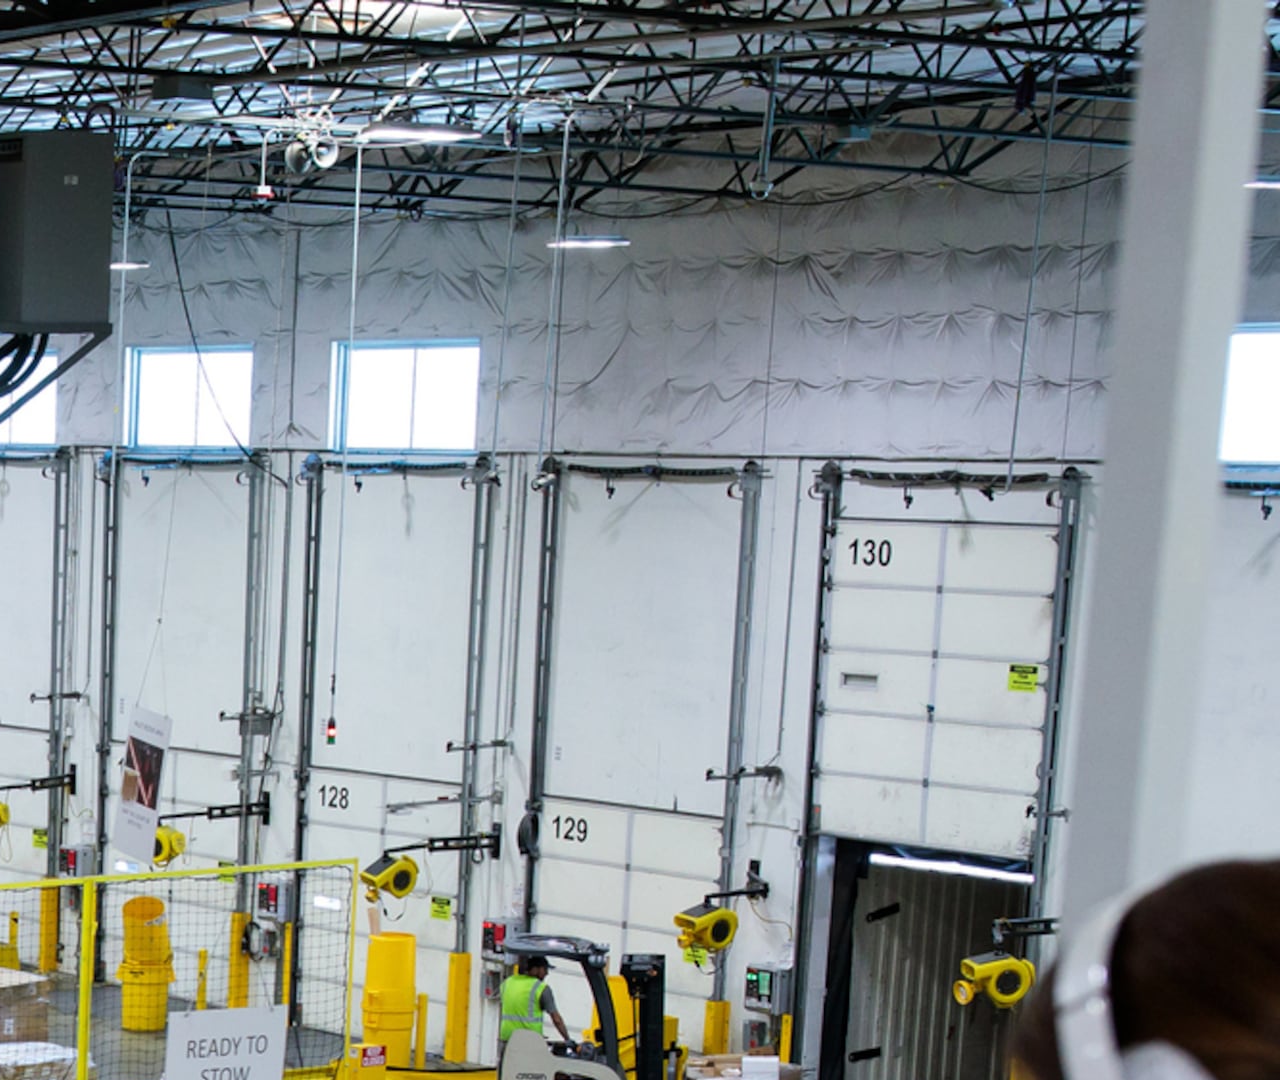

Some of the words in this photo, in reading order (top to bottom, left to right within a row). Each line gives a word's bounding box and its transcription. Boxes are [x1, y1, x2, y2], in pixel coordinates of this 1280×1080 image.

[848, 538, 893, 567] 130
[318, 784, 349, 809] 128
[552, 815, 588, 843] 129
[186, 1036, 242, 1059] READY
[246, 1034, 269, 1054] TO
